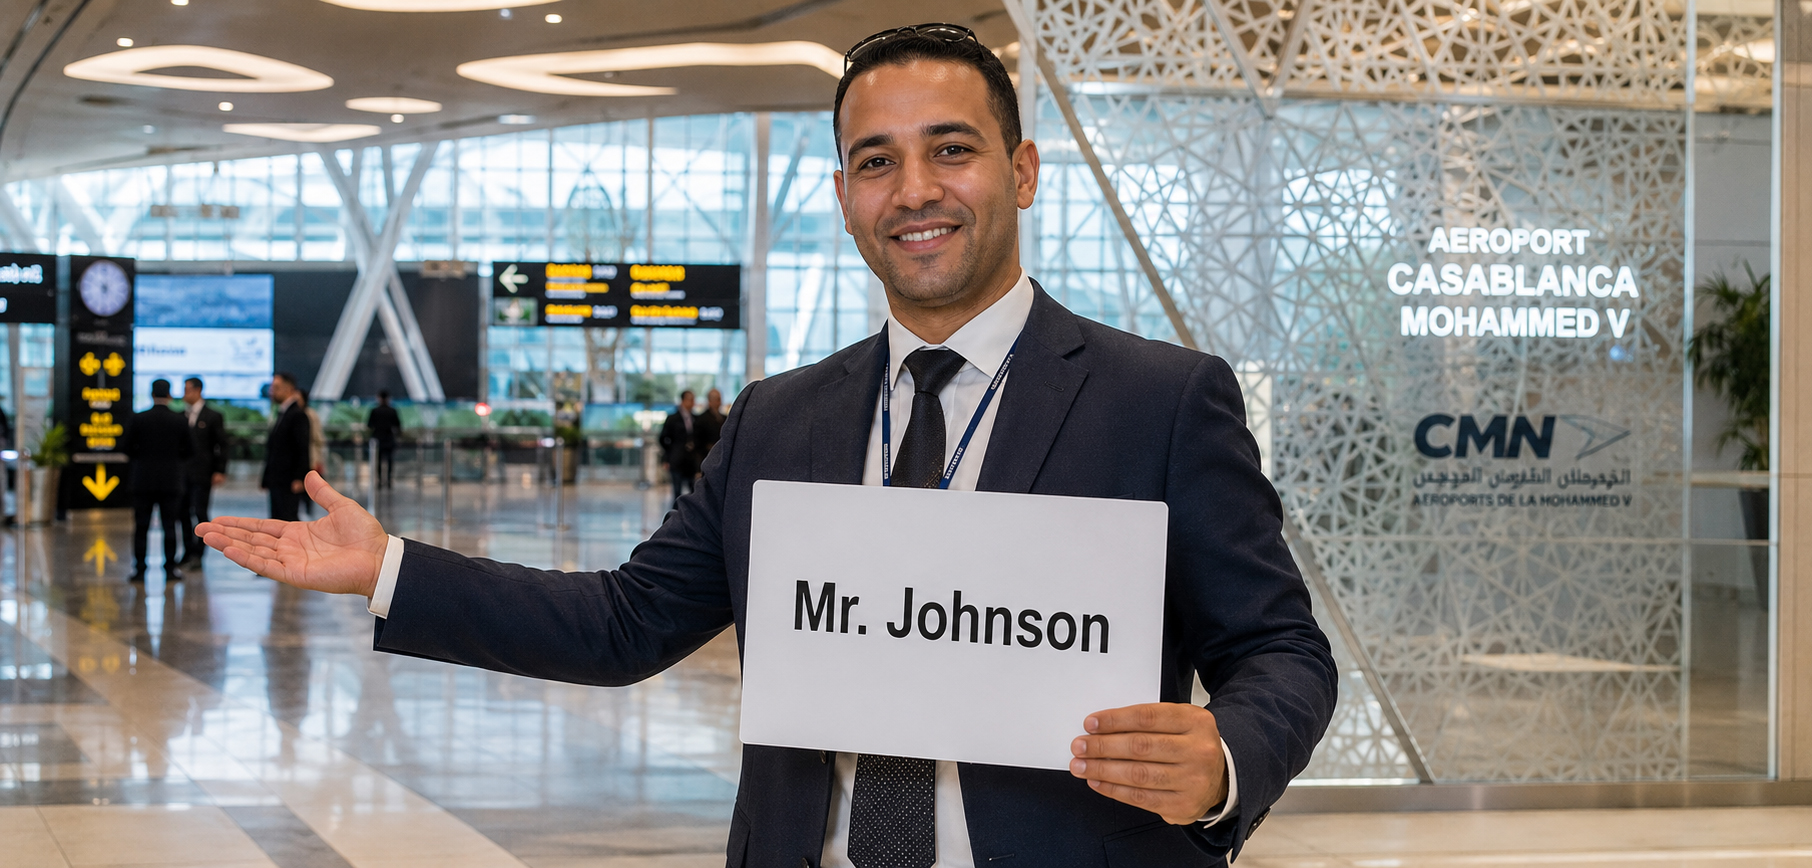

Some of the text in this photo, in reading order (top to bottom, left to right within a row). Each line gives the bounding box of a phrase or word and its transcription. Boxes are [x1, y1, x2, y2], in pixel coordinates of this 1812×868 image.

[1428, 226, 1591, 255] AEROPORT
[1387, 262, 1640, 298] CASABLANCA
[1400, 305, 1631, 339] MOHAMMED V
[1413, 413, 1557, 460] CMN
[1412, 493, 1494, 507] AEROPORTS
[1497, 493, 1516, 507] DE
[1519, 493, 1537, 507] LA
[794, 579, 1110, 654] Mr. Johnson
